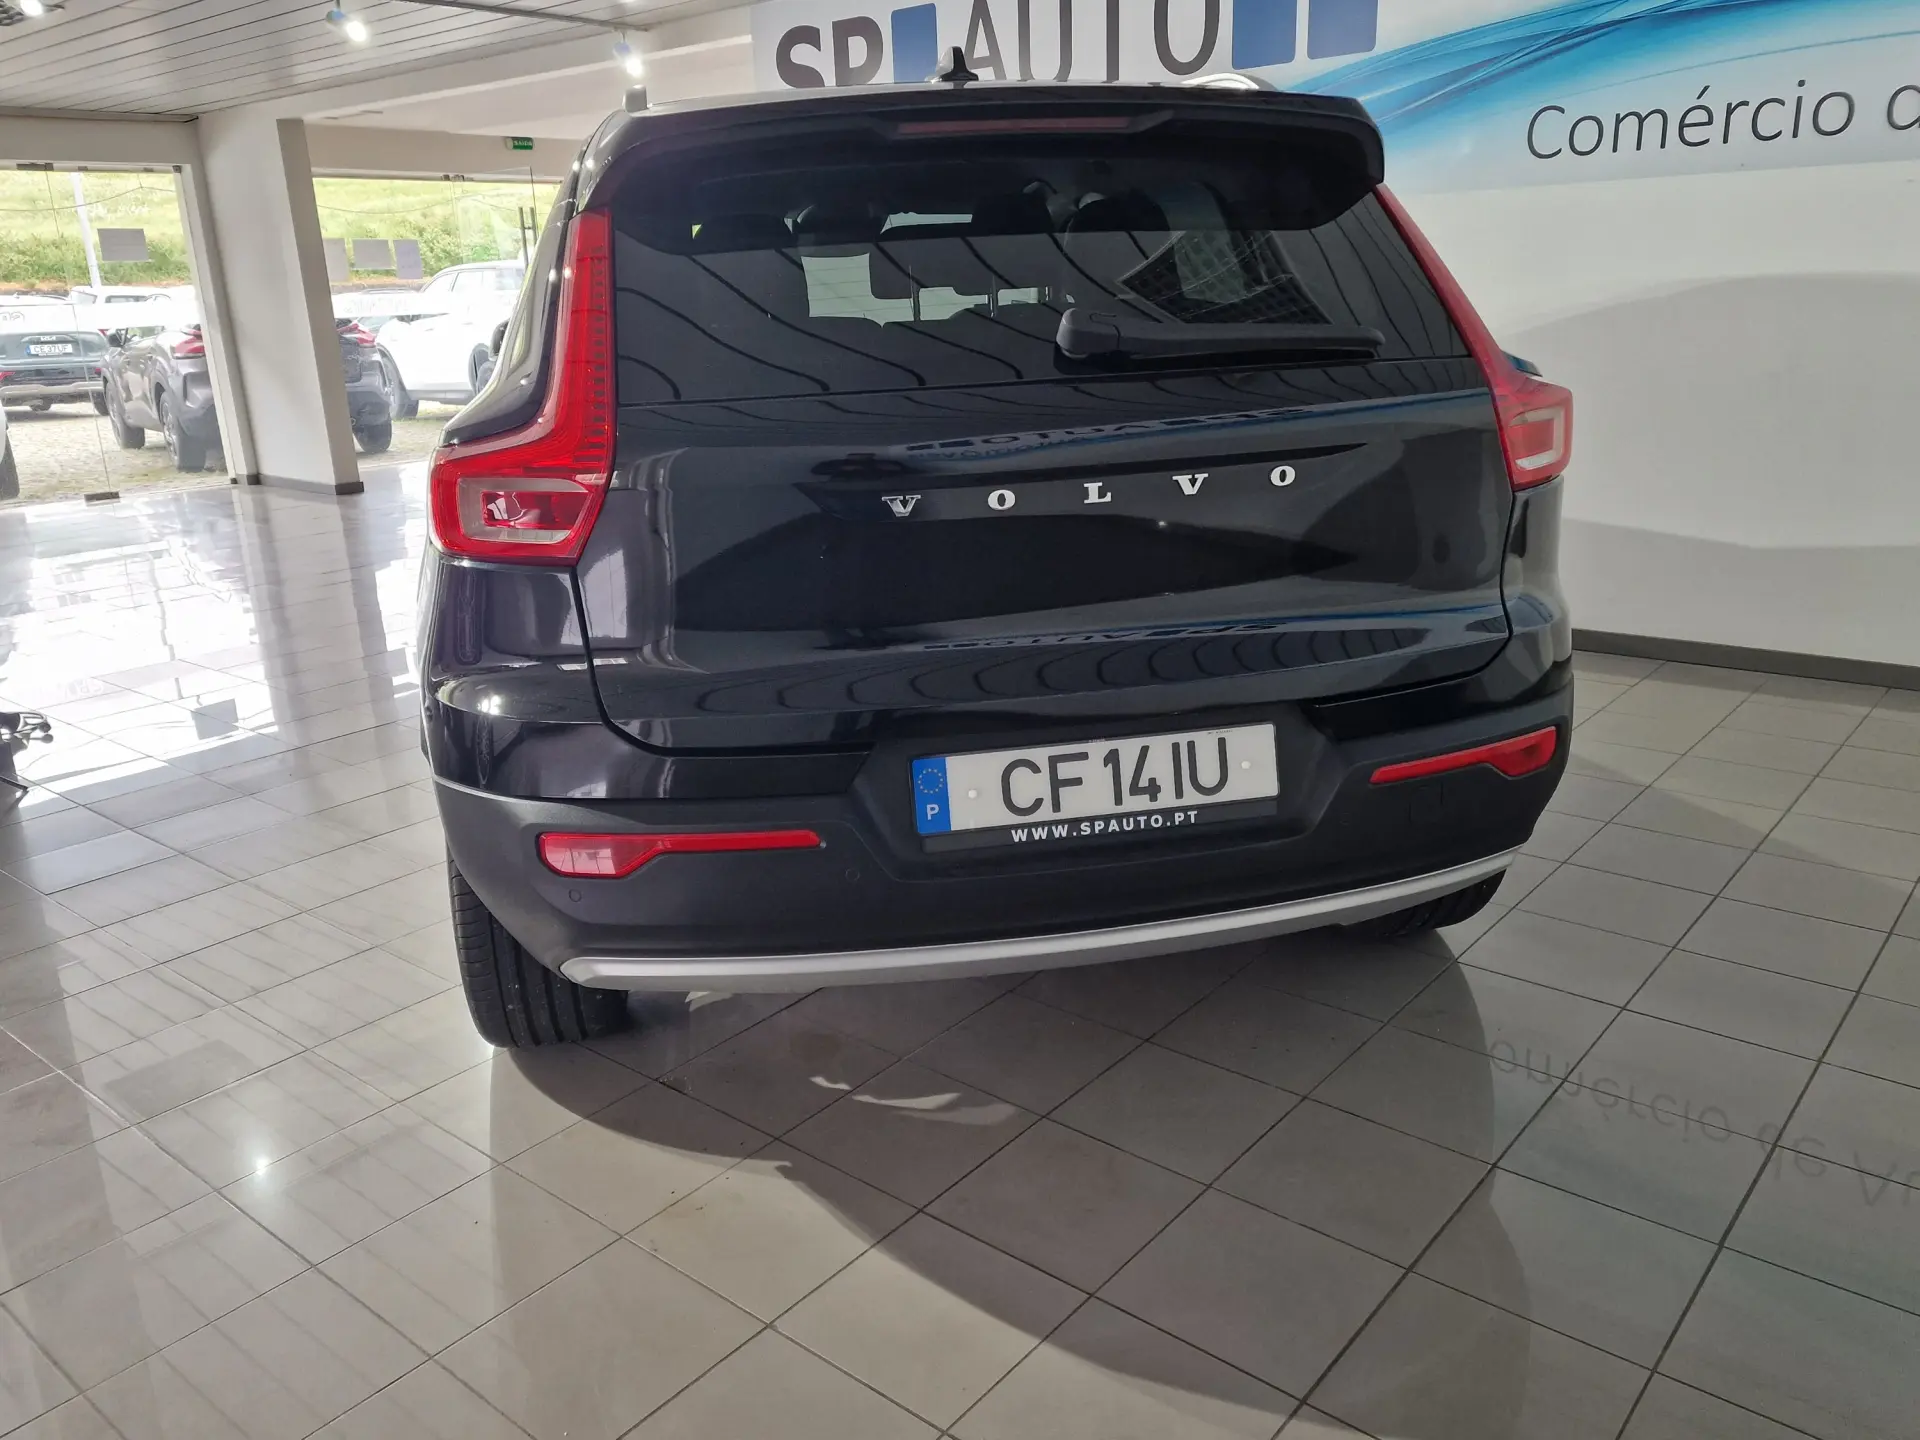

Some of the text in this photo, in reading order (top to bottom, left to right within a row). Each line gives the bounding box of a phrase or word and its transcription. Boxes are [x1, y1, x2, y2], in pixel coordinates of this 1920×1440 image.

[1526, 79, 1856, 160] Comércio
[881, 465, 1296, 517] VOLVO
[1001, 736, 1229, 817] CF 14 IU
[926, 804, 940, 821] P
[1011, 810, 1198, 843] WWW.SPAUTO.PT
